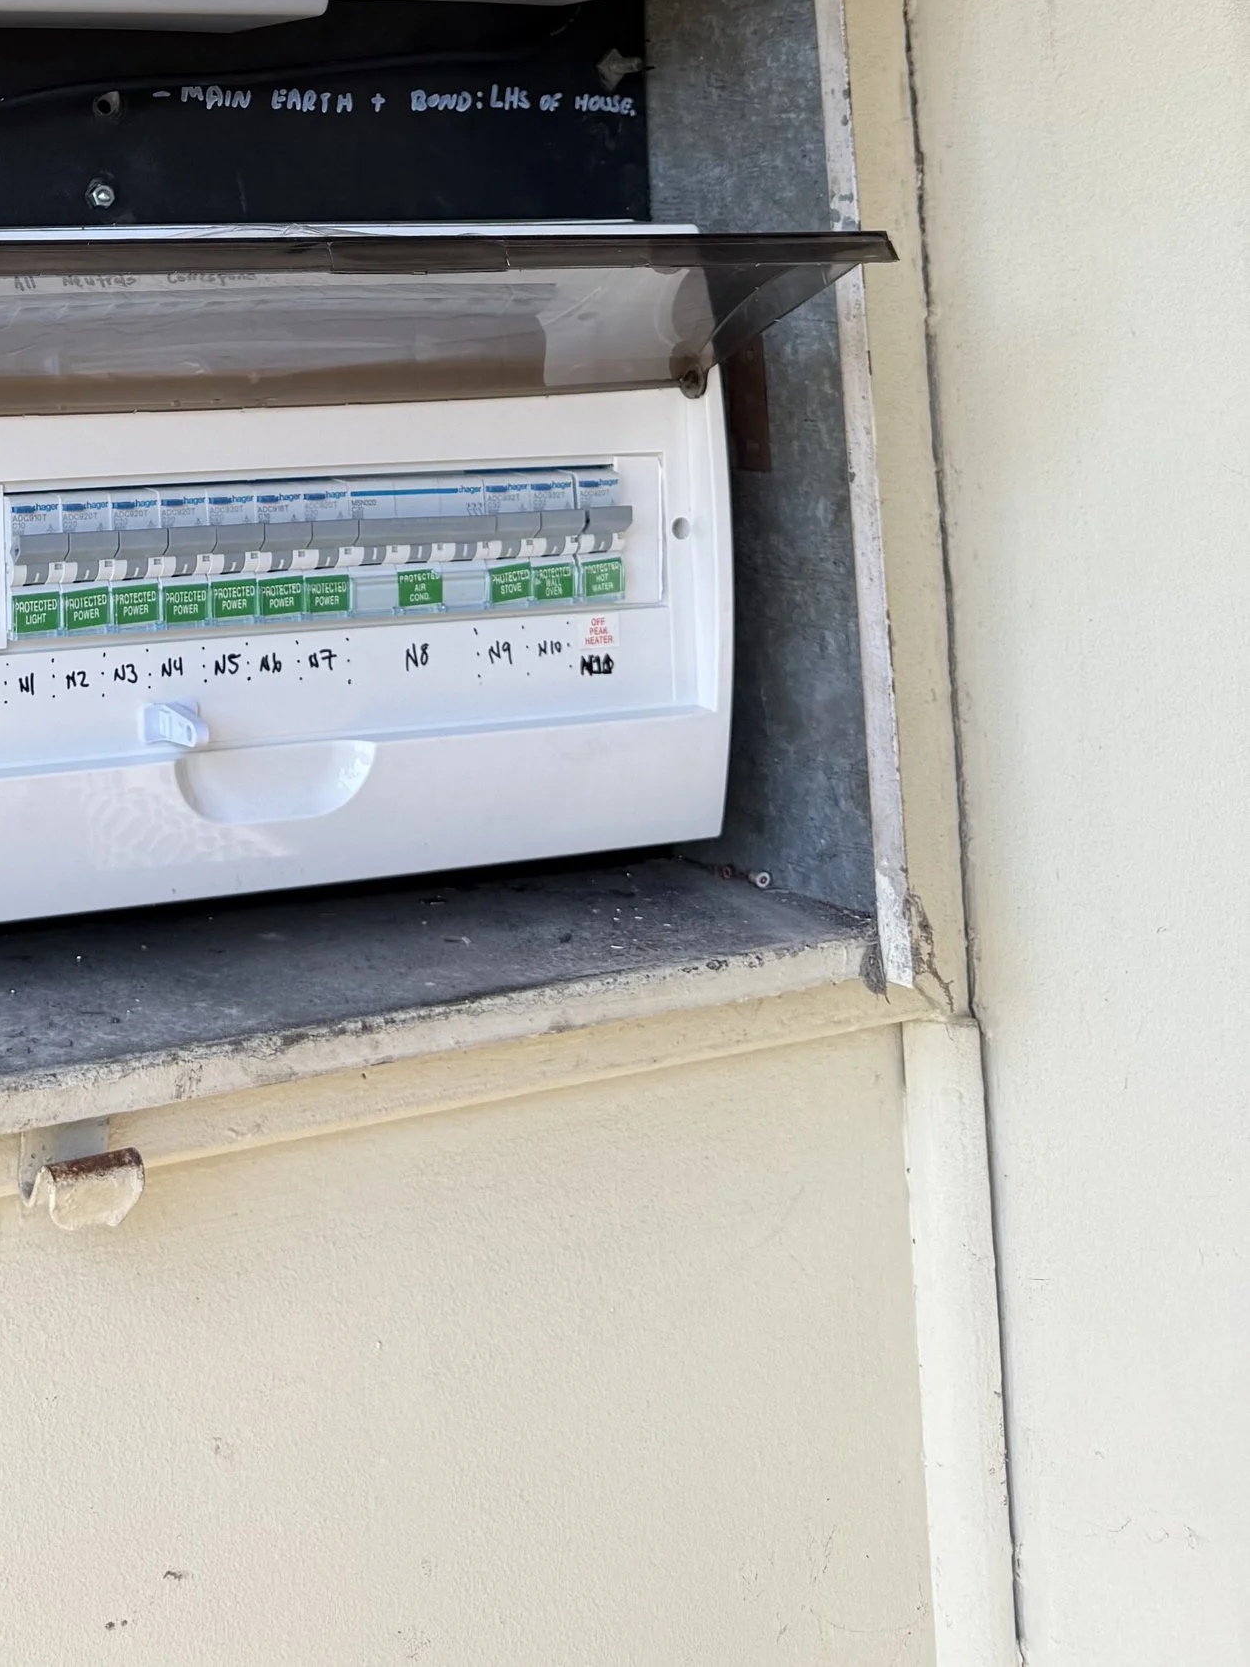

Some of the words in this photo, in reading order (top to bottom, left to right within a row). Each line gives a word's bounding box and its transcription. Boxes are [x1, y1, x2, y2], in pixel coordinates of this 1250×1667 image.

[181, 86, 250, 110] MAIN
[271, 91, 353, 113] EARTH
[539, 92, 562, 112] OF
[492, 569, 530, 584] PROTECTED
[596, 573, 609, 582] HOT
[214, 586, 255, 599] PROTECTED
[262, 583, 301, 596] PROTECTED
[414, 584, 426, 592] AIR
[500, 582, 523, 595] STOVE
[546, 584, 563, 597] OVEN
[592, 582, 614, 592] WATER
[66, 594, 108, 610] PROTECTED
[116, 590, 156, 606] PROTECTED
[166, 590, 207, 604] PROTECTED
[270, 596, 294, 608] POWER
[314, 595, 340, 606] POWER
[16, 598, 58, 612] PROTECTED
[123, 604, 150, 616] POWER
[173, 603, 199, 616] POWER
[222, 598, 248, 610] POWER
[26, 612, 47, 625] LIGHT
[74, 608, 100, 622] POWER
[590, 616, 606, 626] OFF
[589, 626, 608, 636] PEAK
[584, 634, 614, 646] HEATER
[20, 672, 35, 696] N1
[66, 670, 90, 690] N2
[114, 663, 139, 684] N3
[161, 656, 184, 678] N4
[214, 653, 240, 676] N5
[259, 655, 282, 674] N6
[308, 648, 338, 672] N7
[406, 642, 430, 672] N8
[488, 640, 514, 665] N9
[538, 640, 562, 657] N10
